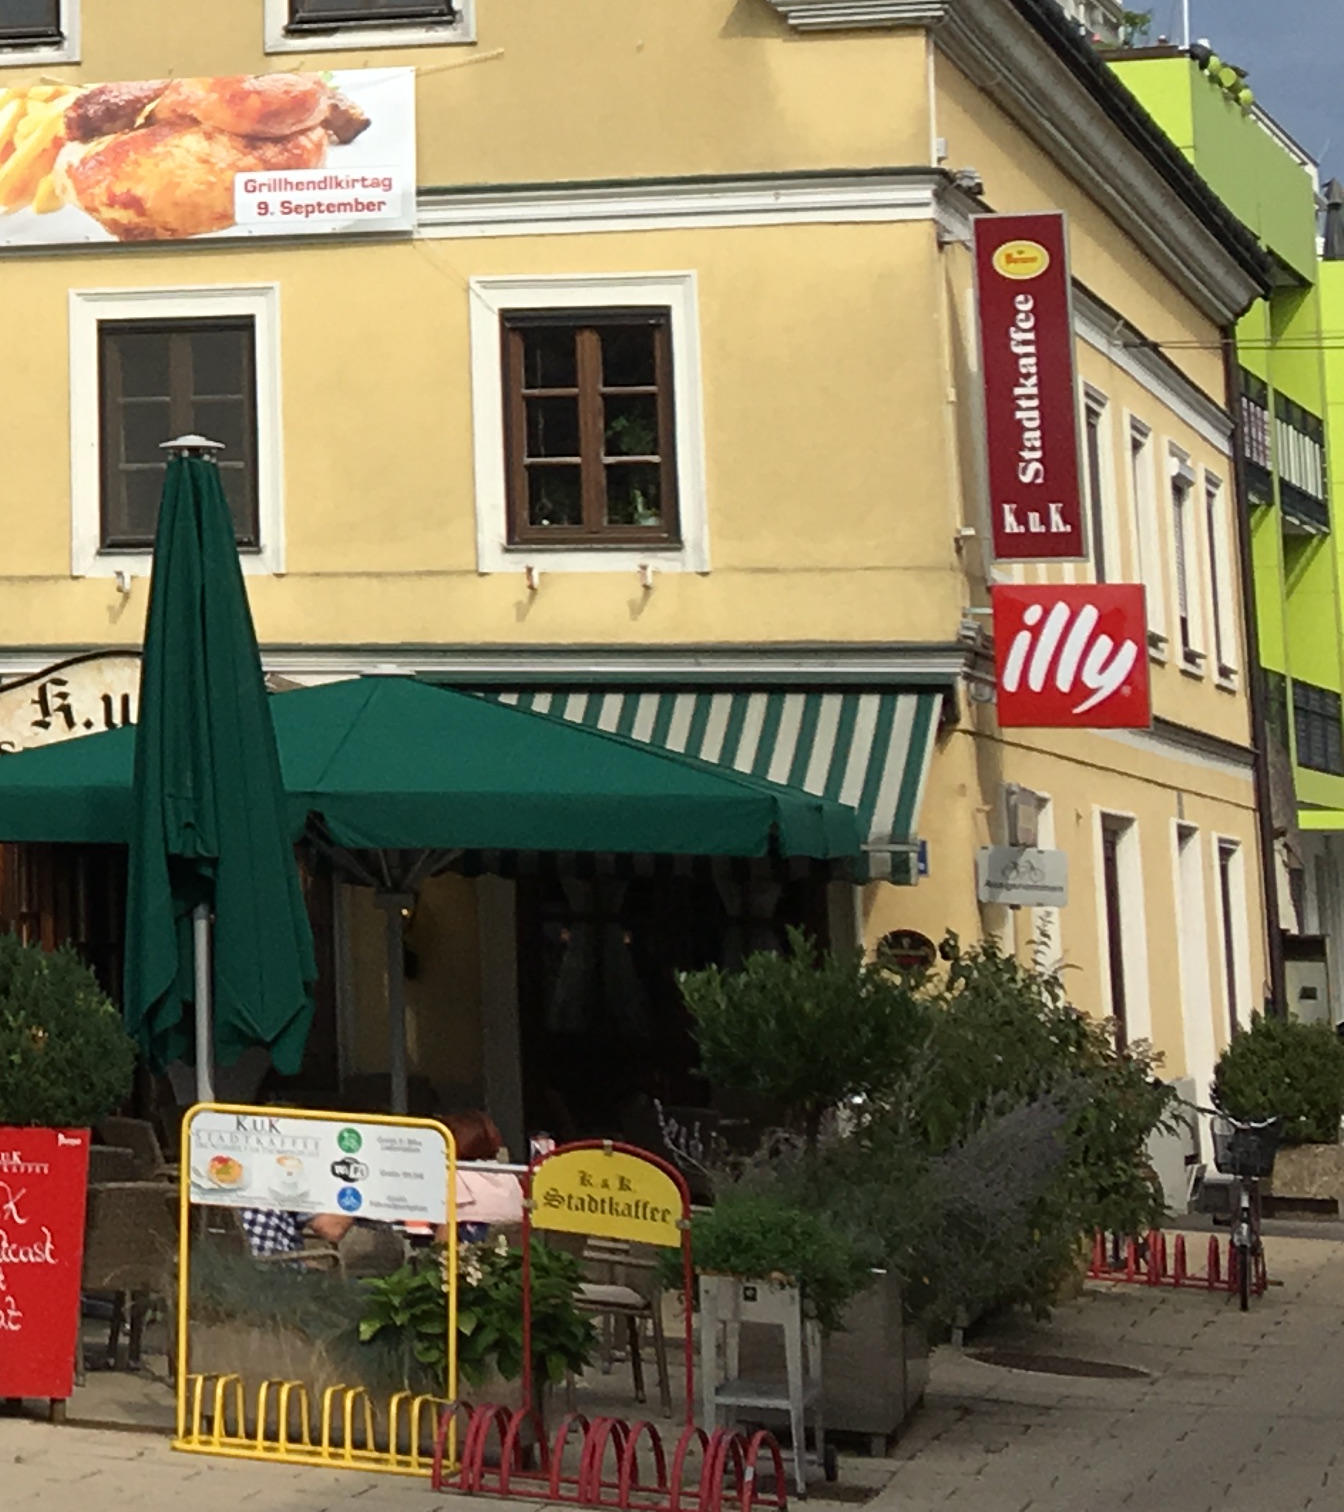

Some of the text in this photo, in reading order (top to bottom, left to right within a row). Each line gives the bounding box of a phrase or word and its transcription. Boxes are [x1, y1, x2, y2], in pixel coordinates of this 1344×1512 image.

[244, 175, 393, 193] Grillhendlkirtag
[257, 198, 386, 218] 9. September
[1010, 294, 1044, 484] Stadtkaffee
[1002, 601, 1138, 714] illy
[543, 1187, 672, 1224] Stadtkaffee
